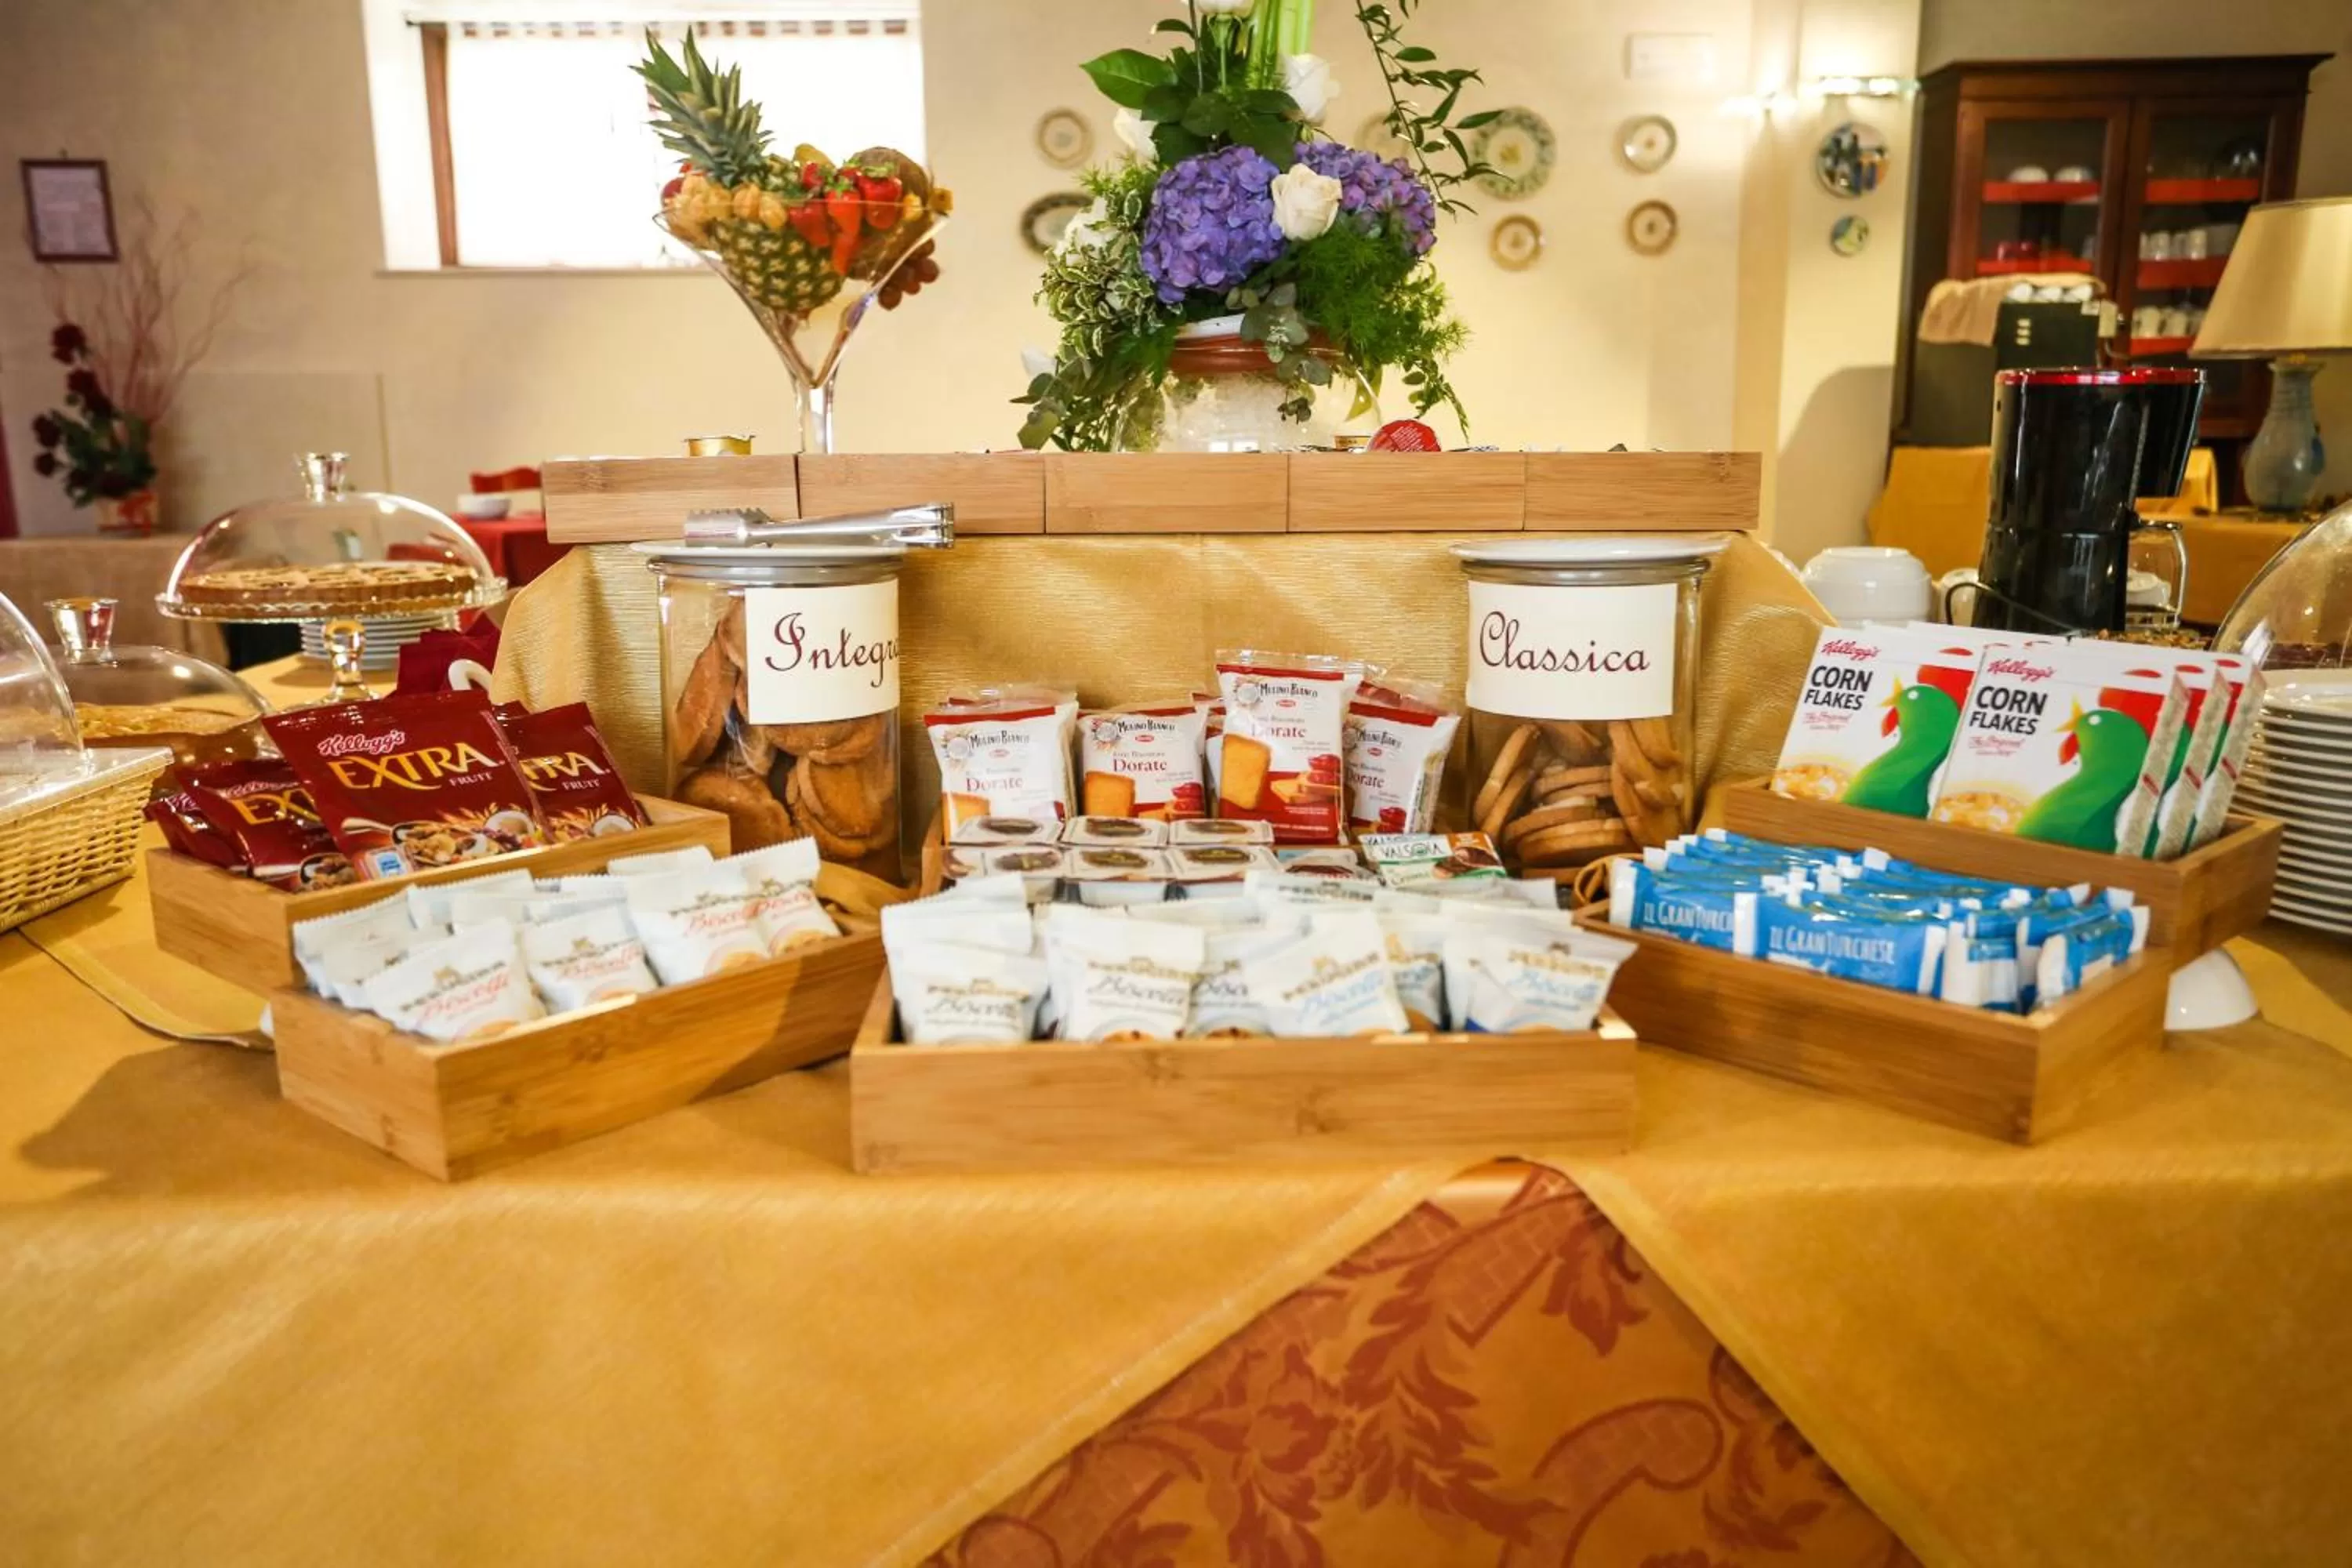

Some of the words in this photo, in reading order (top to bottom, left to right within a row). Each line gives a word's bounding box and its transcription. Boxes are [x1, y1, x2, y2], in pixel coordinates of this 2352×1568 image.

[1480, 611, 1650, 672] Classica
[1821, 639, 1882, 661] Kellogg's
[1811, 665, 1874, 692] CORN
[1987, 658, 2057, 682] Kellogg's
[1804, 688, 1866, 711] FLAKES
[1976, 685, 2049, 717] CORN
[1969, 710, 2040, 735] FLAKES
[317, 728, 406, 757] Kellogg's
[326, 742, 500, 790] EXTRA
[518, 751, 605, 791] TRA
[1112, 757, 1168, 773] Dorate
[448, 771, 493, 787] FRUIT
[561, 779, 601, 791] FRUIT
